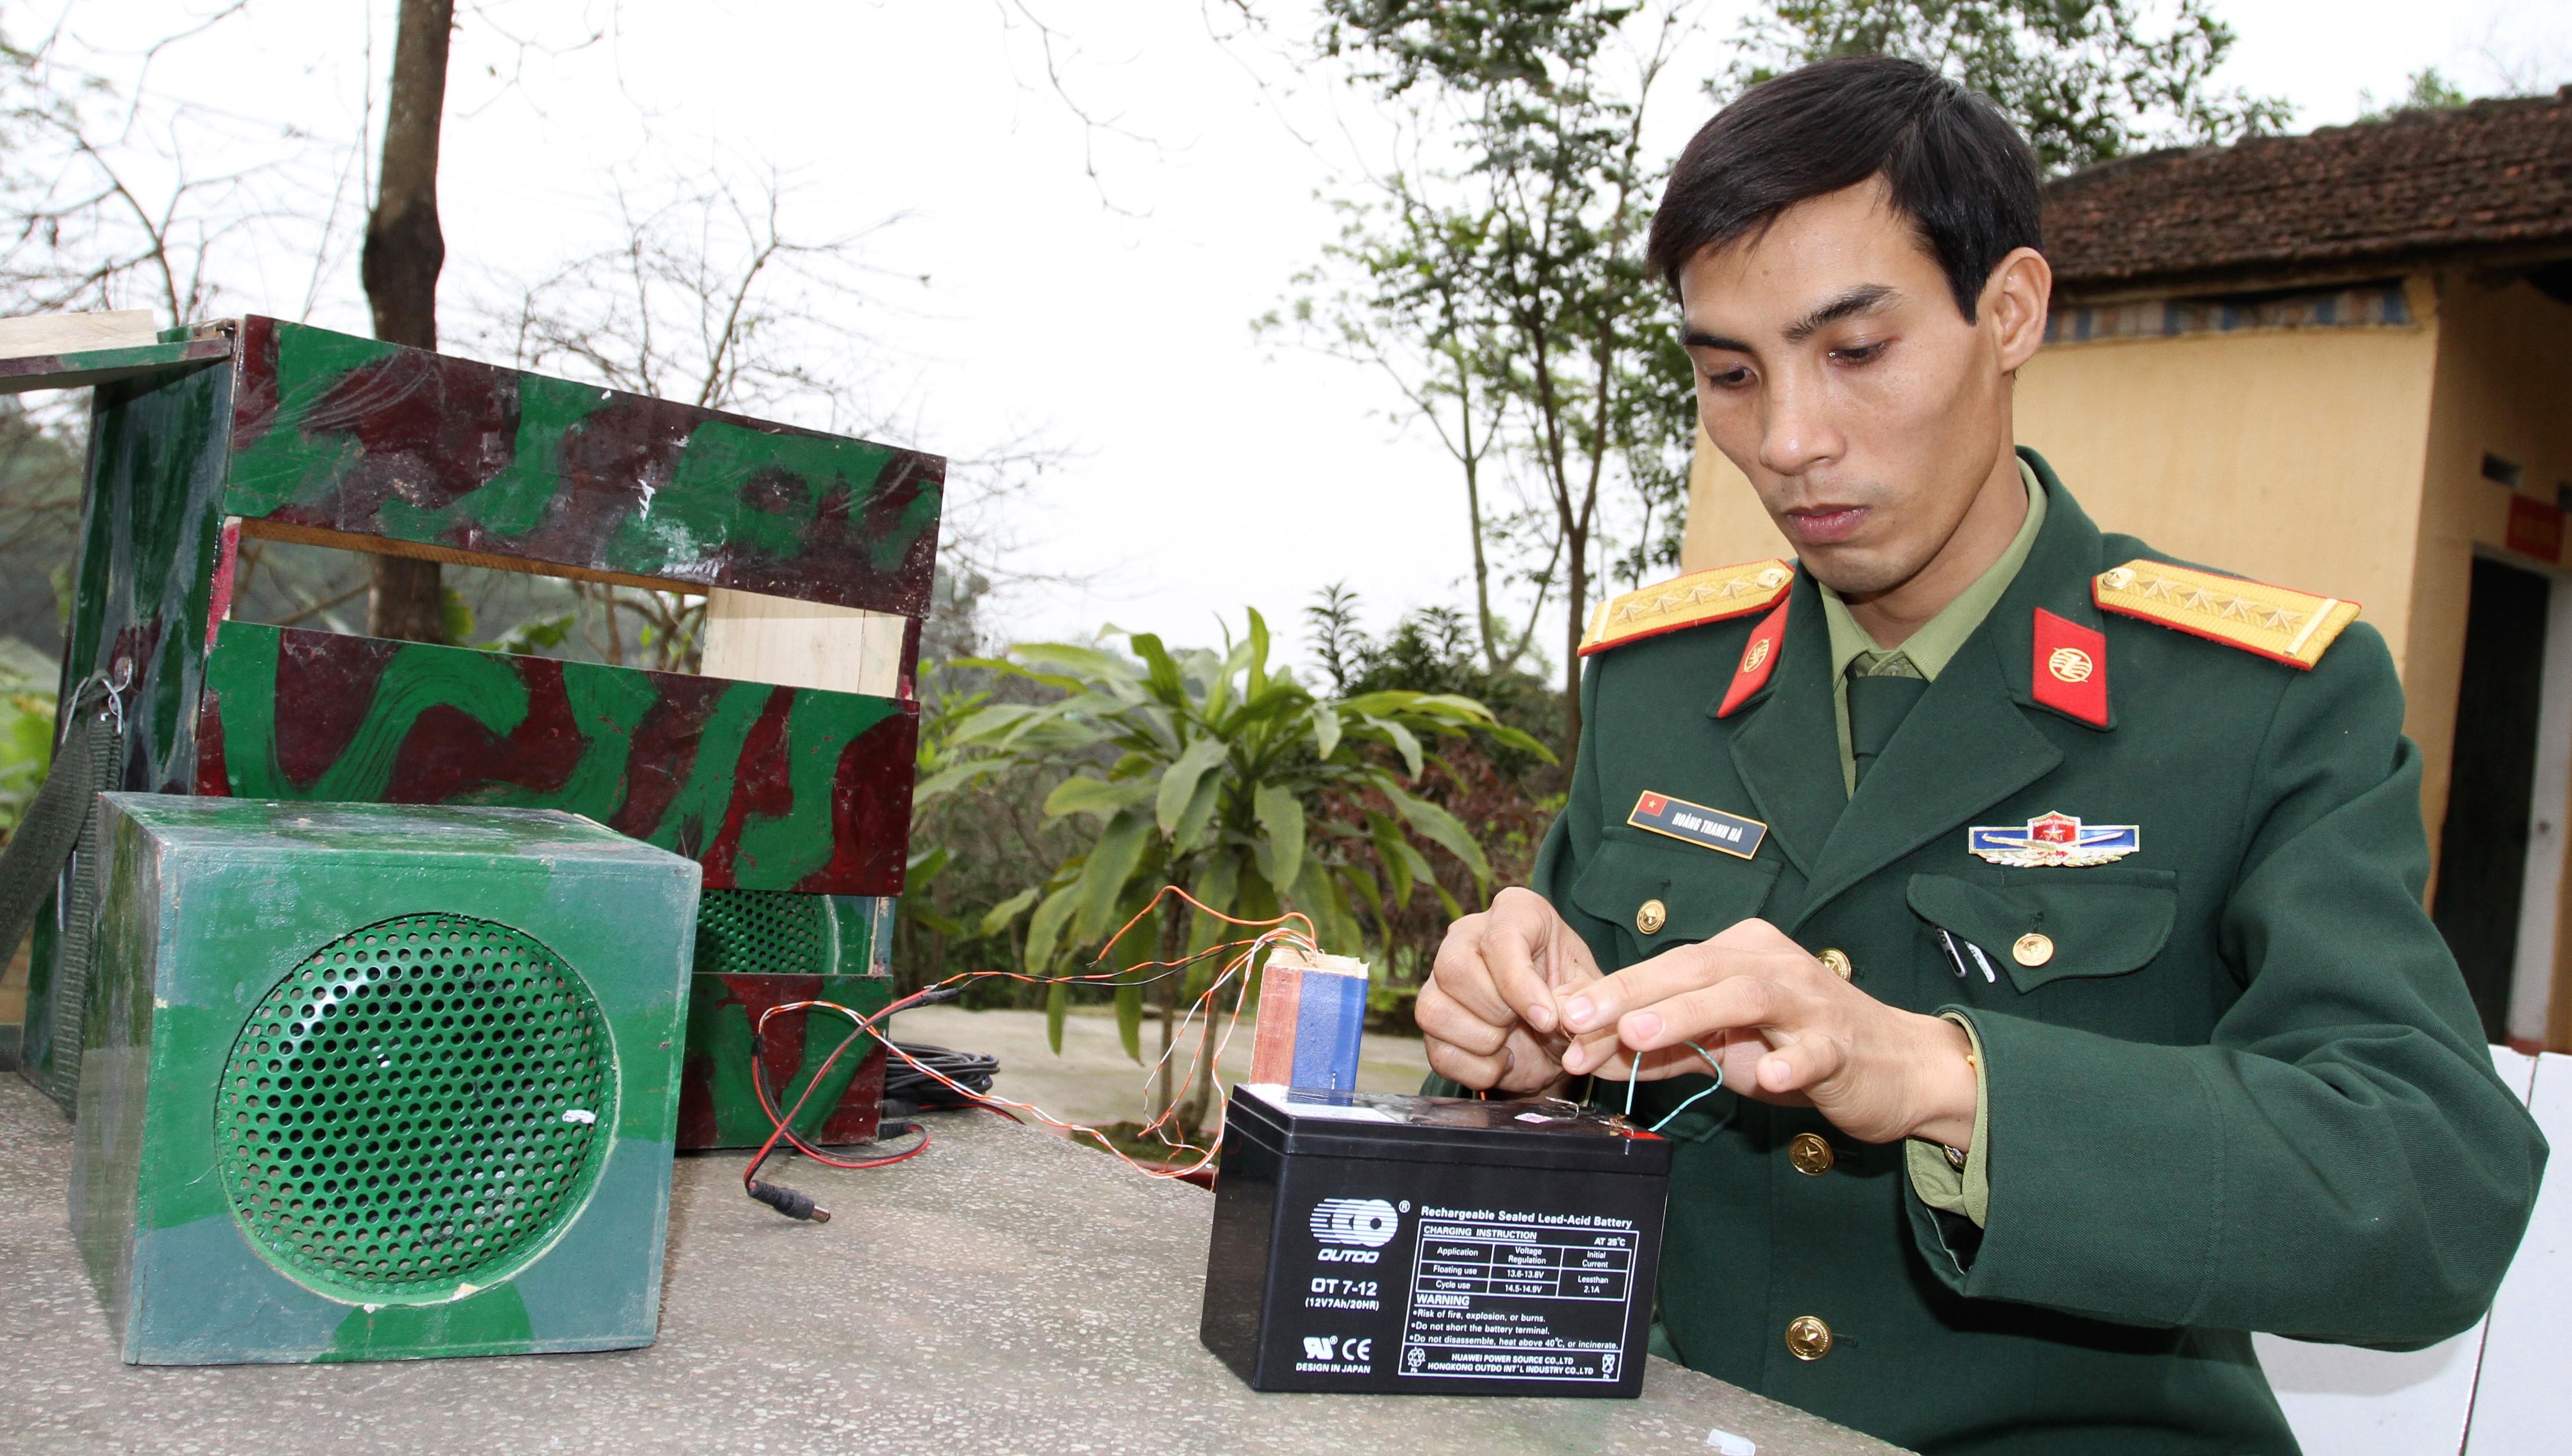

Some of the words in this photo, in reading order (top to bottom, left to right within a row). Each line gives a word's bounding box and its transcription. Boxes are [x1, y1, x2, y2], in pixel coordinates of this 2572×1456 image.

[1700, 819, 1730, 839] THANH
[1421, 1205, 1495, 1220] Rechargeable
[1497, 1210, 1536, 1223] Sealed
[1538, 1213, 1591, 1226] Lead-Acid
[1593, 1216, 1633, 1230] Battery
[1423, 1226, 1472, 1236] CHARGING
[1476, 1228, 1537, 1239] INSTRUCTION
[1594, 1237, 1606, 1246] AT
[1317, 1249, 1380, 1264] OUTDO
[1437, 1246, 1478, 1257] Application
[1515, 1246, 1543, 1256] Voltage
[1587, 1250, 1607, 1259] Initial
[1508, 1254, 1547, 1265] Regulation
[1582, 1260, 1608, 1268] Current
[1433, 1264, 1462, 1275] Floating
[1464, 1267, 1477, 1275] use
[1507, 1269, 1544, 1279] 13.6-13.8V
[1310, 1278, 1339, 1294] OT
[1342, 1280, 1378, 1297] 7-12
[1436, 1279, 1456, 1290] Cycle
[1505, 1284, 1543, 1294] 14.5-14.9V
[1584, 1286, 1600, 1294] 2.1A
[1304, 1297, 1380, 1312] (12V7Ah/20HR)
[1416, 1294, 1470, 1305] WARNING
[1447, 1310, 1463, 1320] fire,
[1466, 1313, 1507, 1322] explosion,
[1521, 1313, 1546, 1323] burns.
[1445, 1323, 1468, 1332] short
[1469, 1324, 1483, 1333] the
[1485, 1324, 1514, 1335] battery
[1515, 1327, 1550, 1335] terminal.
[1444, 1335, 1496, 1346] disassemble,
[1499, 1336, 1517, 1346] heat
[1518, 1338, 1543, 1347] above
[1578, 1340, 1618, 1349] incinerate.
[1451, 1354, 1483, 1362] HUAWEI
[1484, 1354, 1512, 1364] POWER
[1512, 1355, 1543, 1364] SOURCE
[1544, 1356, 1574, 1365] CO.,LTD
[1296, 1362, 1329, 1372] DESIGN
[1330, 1364, 1340, 1372] IN
[1341, 1364, 1371, 1374] JAPAN
[1428, 1362, 1474, 1372] HONGKONG
[1474, 1364, 1503, 1372] OUTDO
[1526, 1366, 1564, 1375] INDUSTRY
[1564, 1366, 1594, 1376] CO.,LTD
